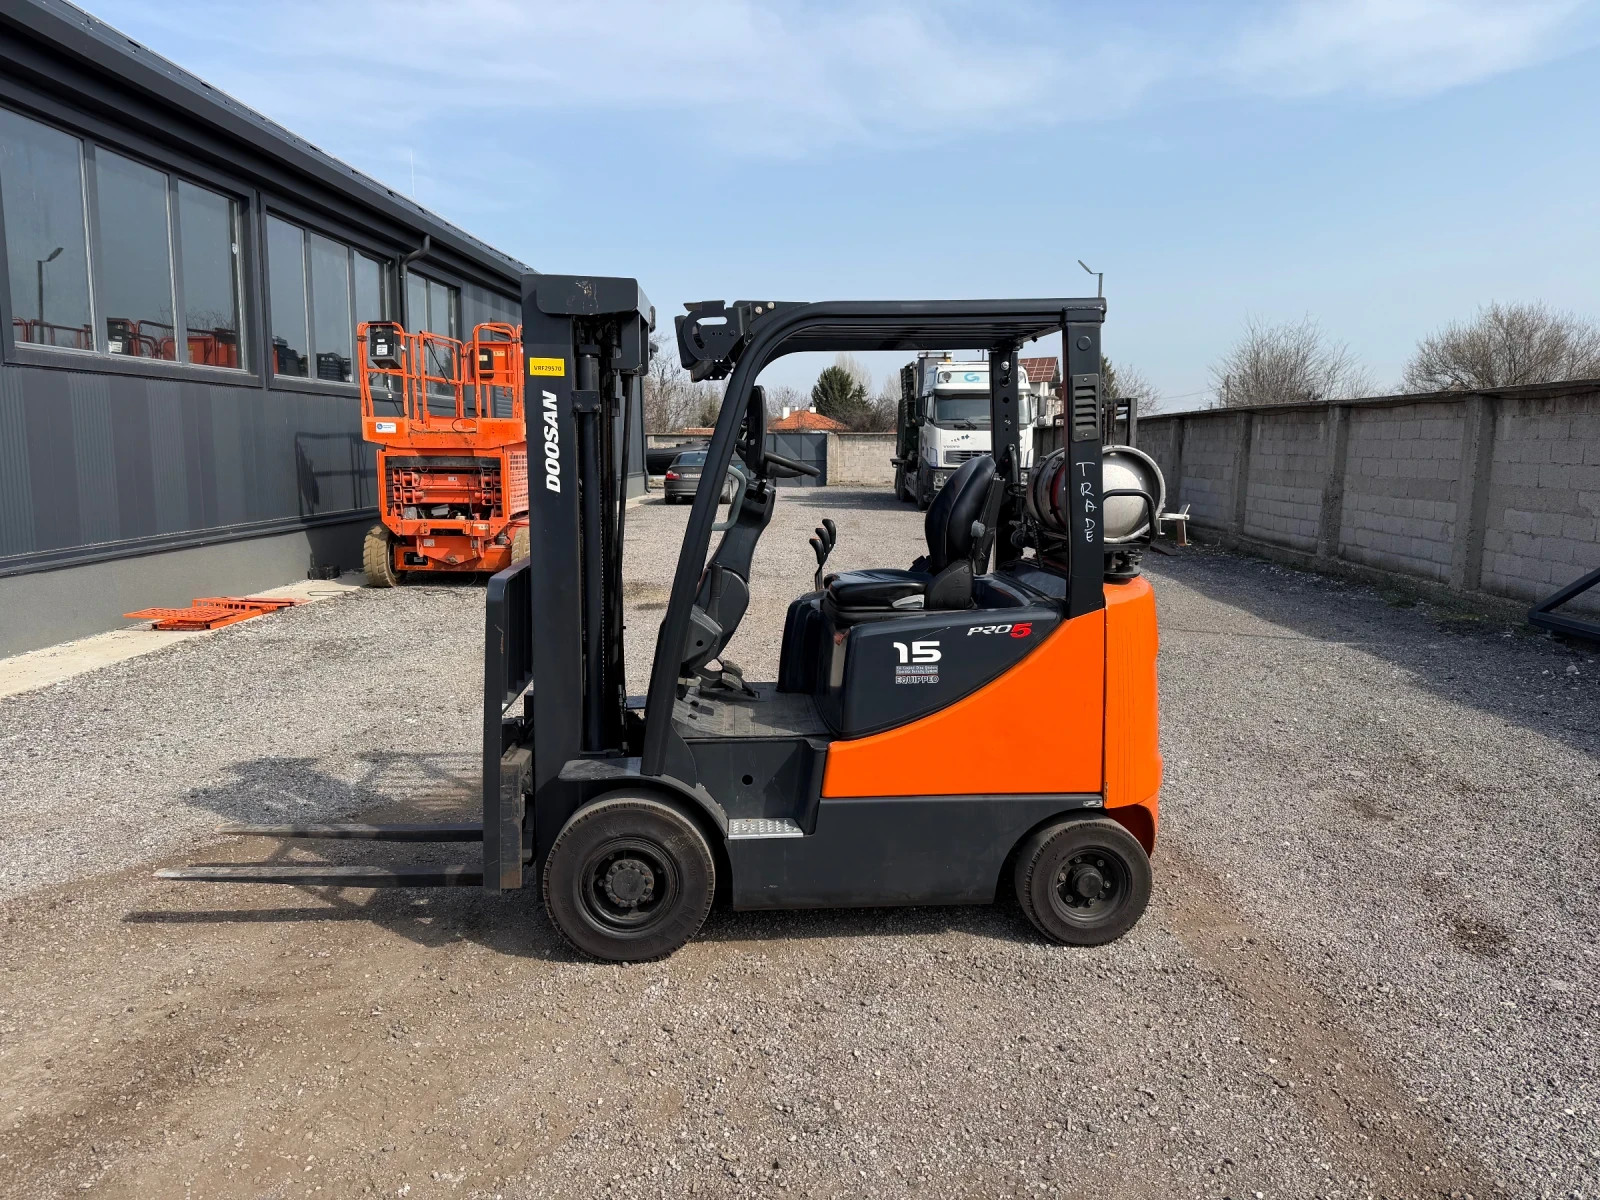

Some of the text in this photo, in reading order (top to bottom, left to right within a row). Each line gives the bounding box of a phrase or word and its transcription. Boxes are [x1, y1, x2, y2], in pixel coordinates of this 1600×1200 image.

[542, 390, 561, 493] DOOSAN
[1076, 461, 1097, 542] TRADE
[893, 640, 942, 663] 15
